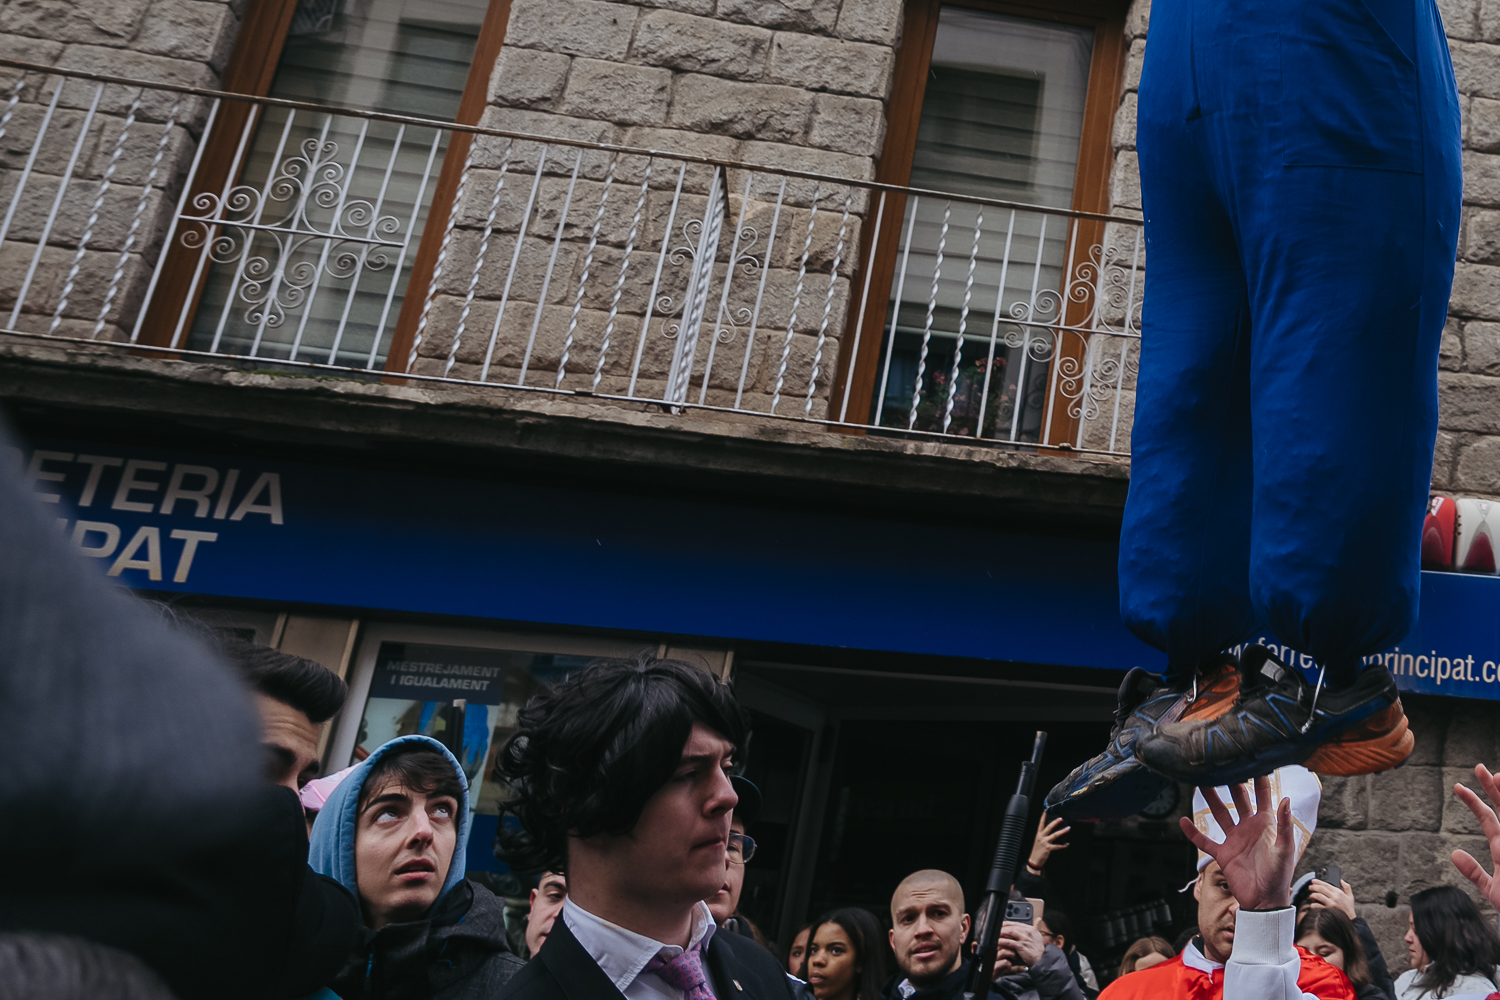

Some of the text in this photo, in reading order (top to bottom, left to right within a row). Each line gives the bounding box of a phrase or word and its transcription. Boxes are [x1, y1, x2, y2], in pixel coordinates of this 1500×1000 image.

[387, 661, 500, 678] MESTREJAMENT
[391, 675, 490, 691] I IGUALAMENT
